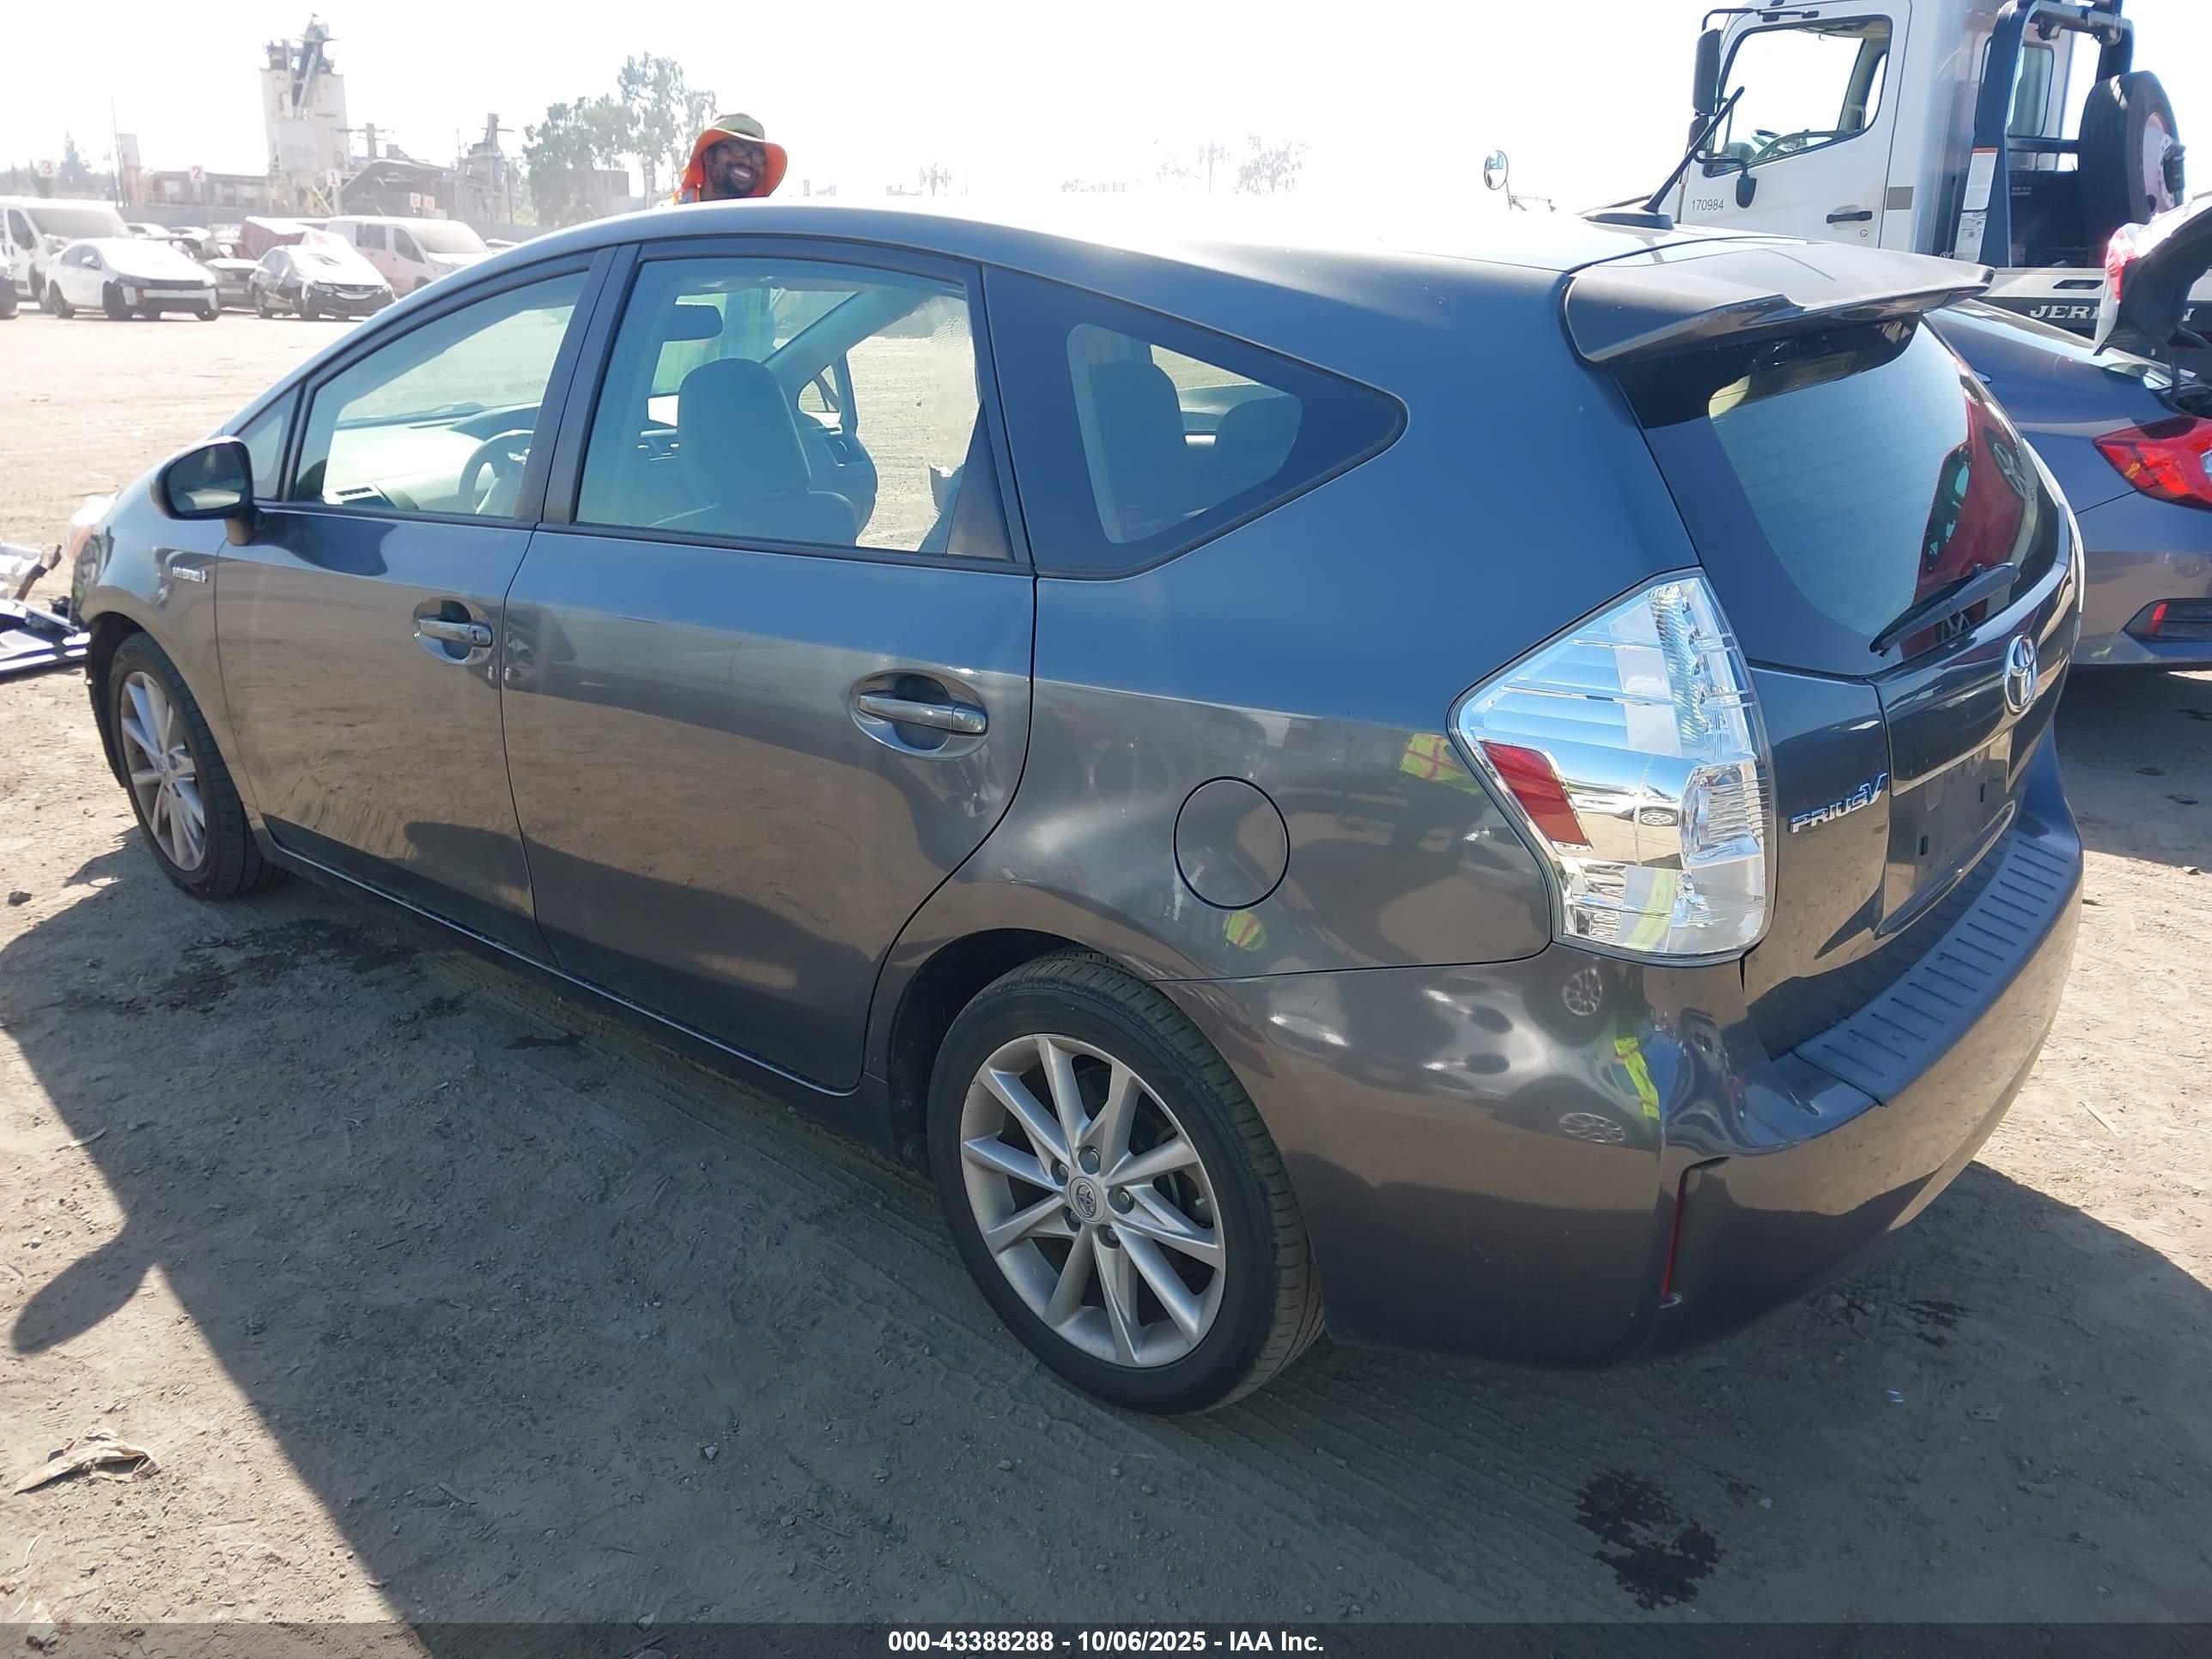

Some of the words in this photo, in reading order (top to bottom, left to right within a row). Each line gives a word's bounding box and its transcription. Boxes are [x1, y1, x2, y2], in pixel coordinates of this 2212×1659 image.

[192, 166, 202, 179] 2
[1692, 198, 1724, 211] 170984
[1790, 788, 1869, 834] PRIUS
